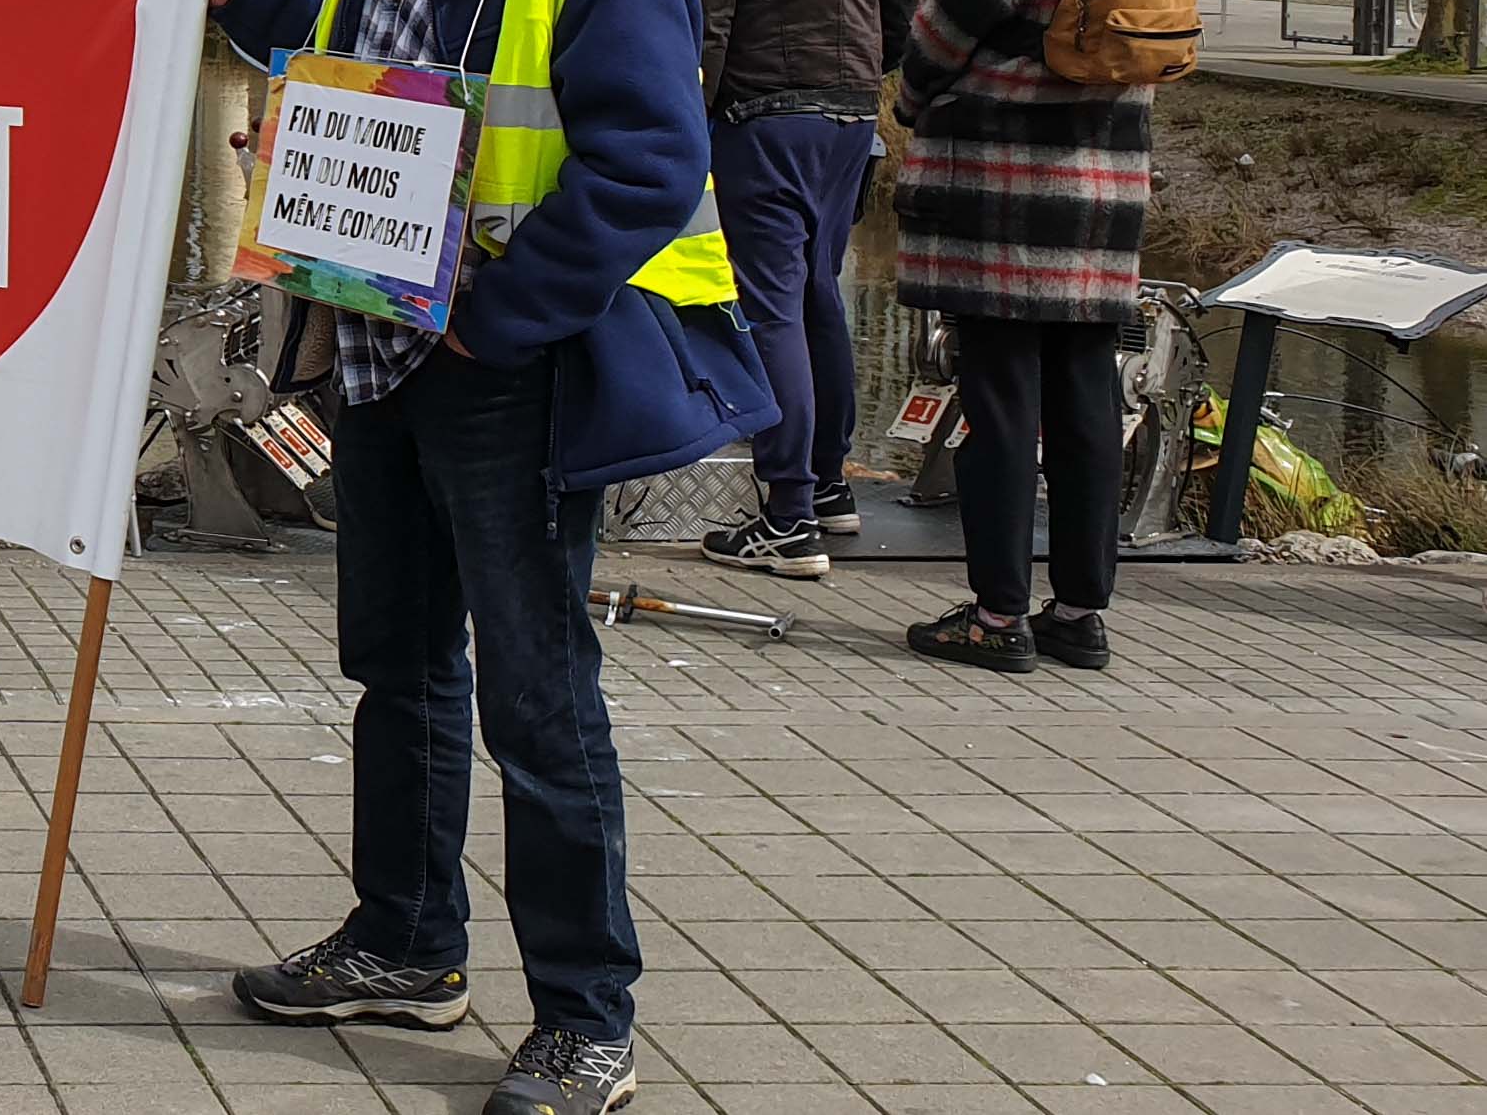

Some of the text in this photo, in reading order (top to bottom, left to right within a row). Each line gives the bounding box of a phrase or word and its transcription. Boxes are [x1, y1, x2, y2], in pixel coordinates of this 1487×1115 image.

[288, 105, 427, 156] FIN DU MONDE
[282, 149, 401, 199] FIN DU MOIS
[273, 193, 337, 232] MÊME
